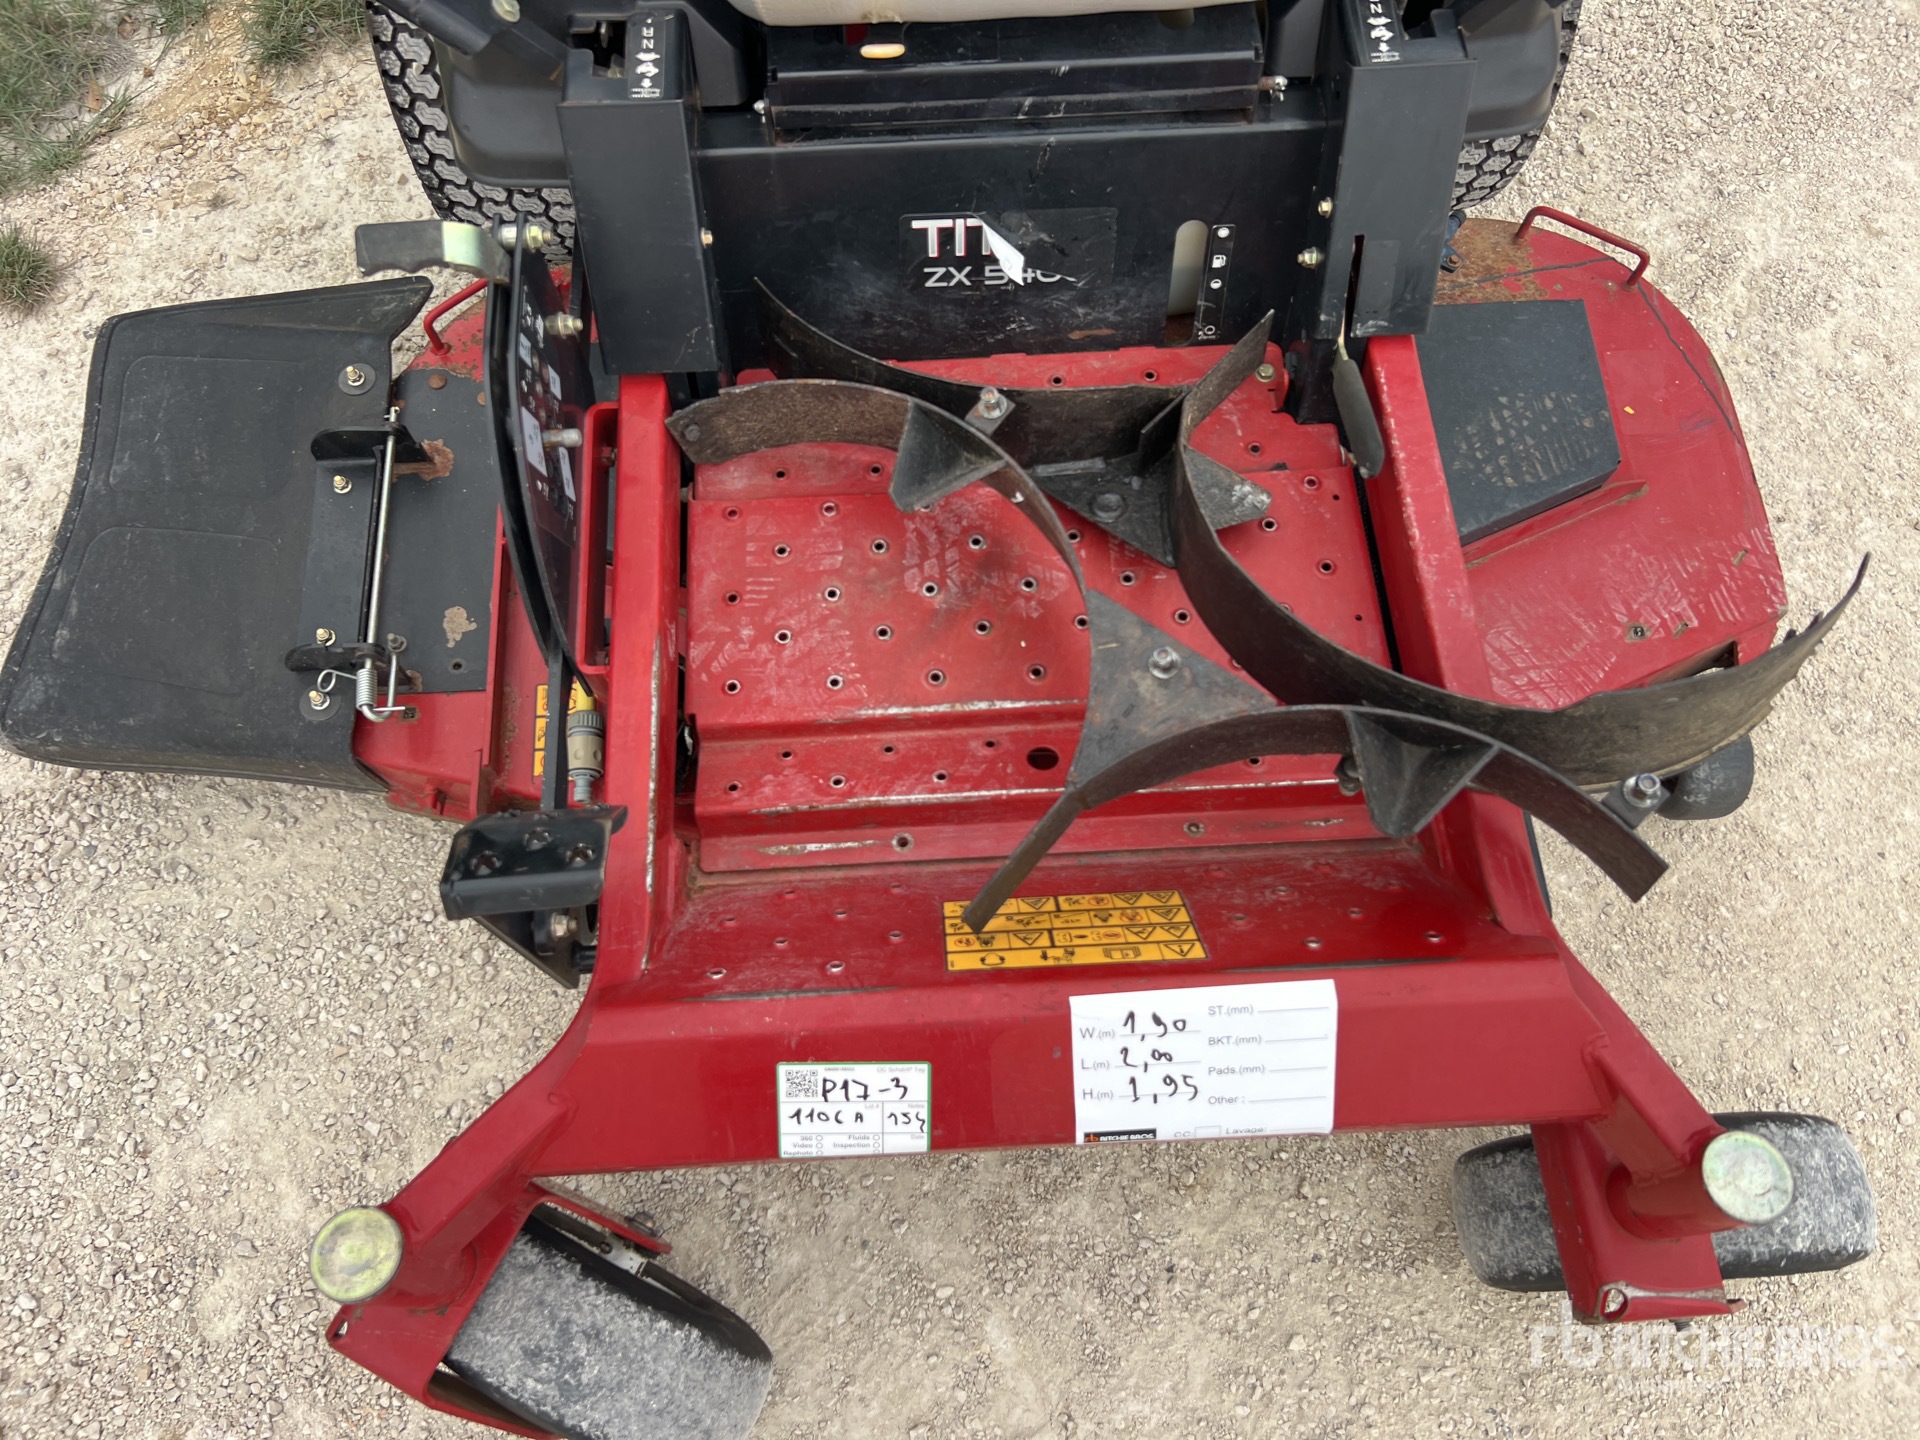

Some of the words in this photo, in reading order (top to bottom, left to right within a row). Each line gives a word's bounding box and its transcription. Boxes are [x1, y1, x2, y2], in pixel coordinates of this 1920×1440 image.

[923, 266, 972, 288] ZX
[1080, 1026, 1116, 1040] W.(m)
[1208, 1034, 1263, 1047] BKT.(mm)
[1080, 1058, 1110, 1071] L.(m)
[1208, 1064, 1266, 1077] Pads.(mm)
[1082, 1089, 1114, 1101] H.(m)
[1128, 1074, 1199, 1105] 1,95
